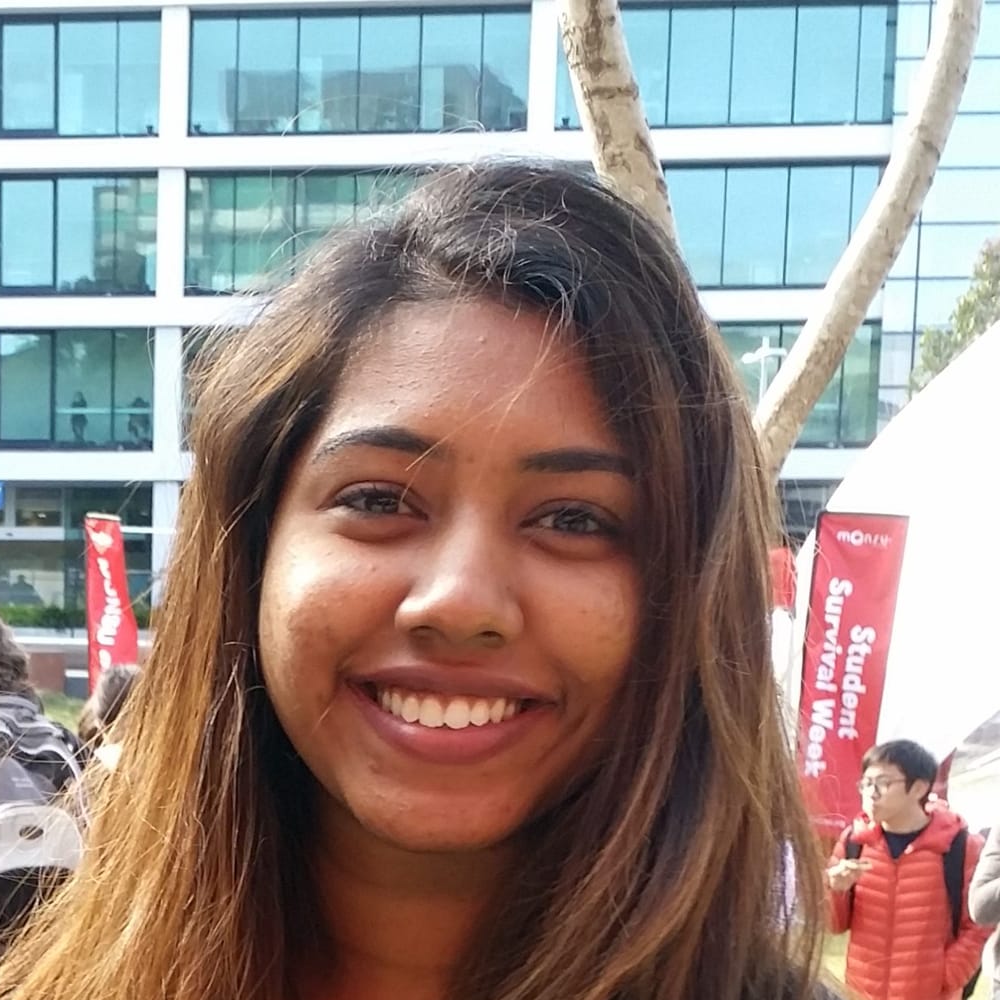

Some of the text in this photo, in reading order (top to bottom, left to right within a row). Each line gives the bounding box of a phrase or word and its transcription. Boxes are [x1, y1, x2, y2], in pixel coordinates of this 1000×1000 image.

[815, 577, 852, 692] Survival
[838, 624, 875, 739] Student
[804, 699, 835, 778] Week
